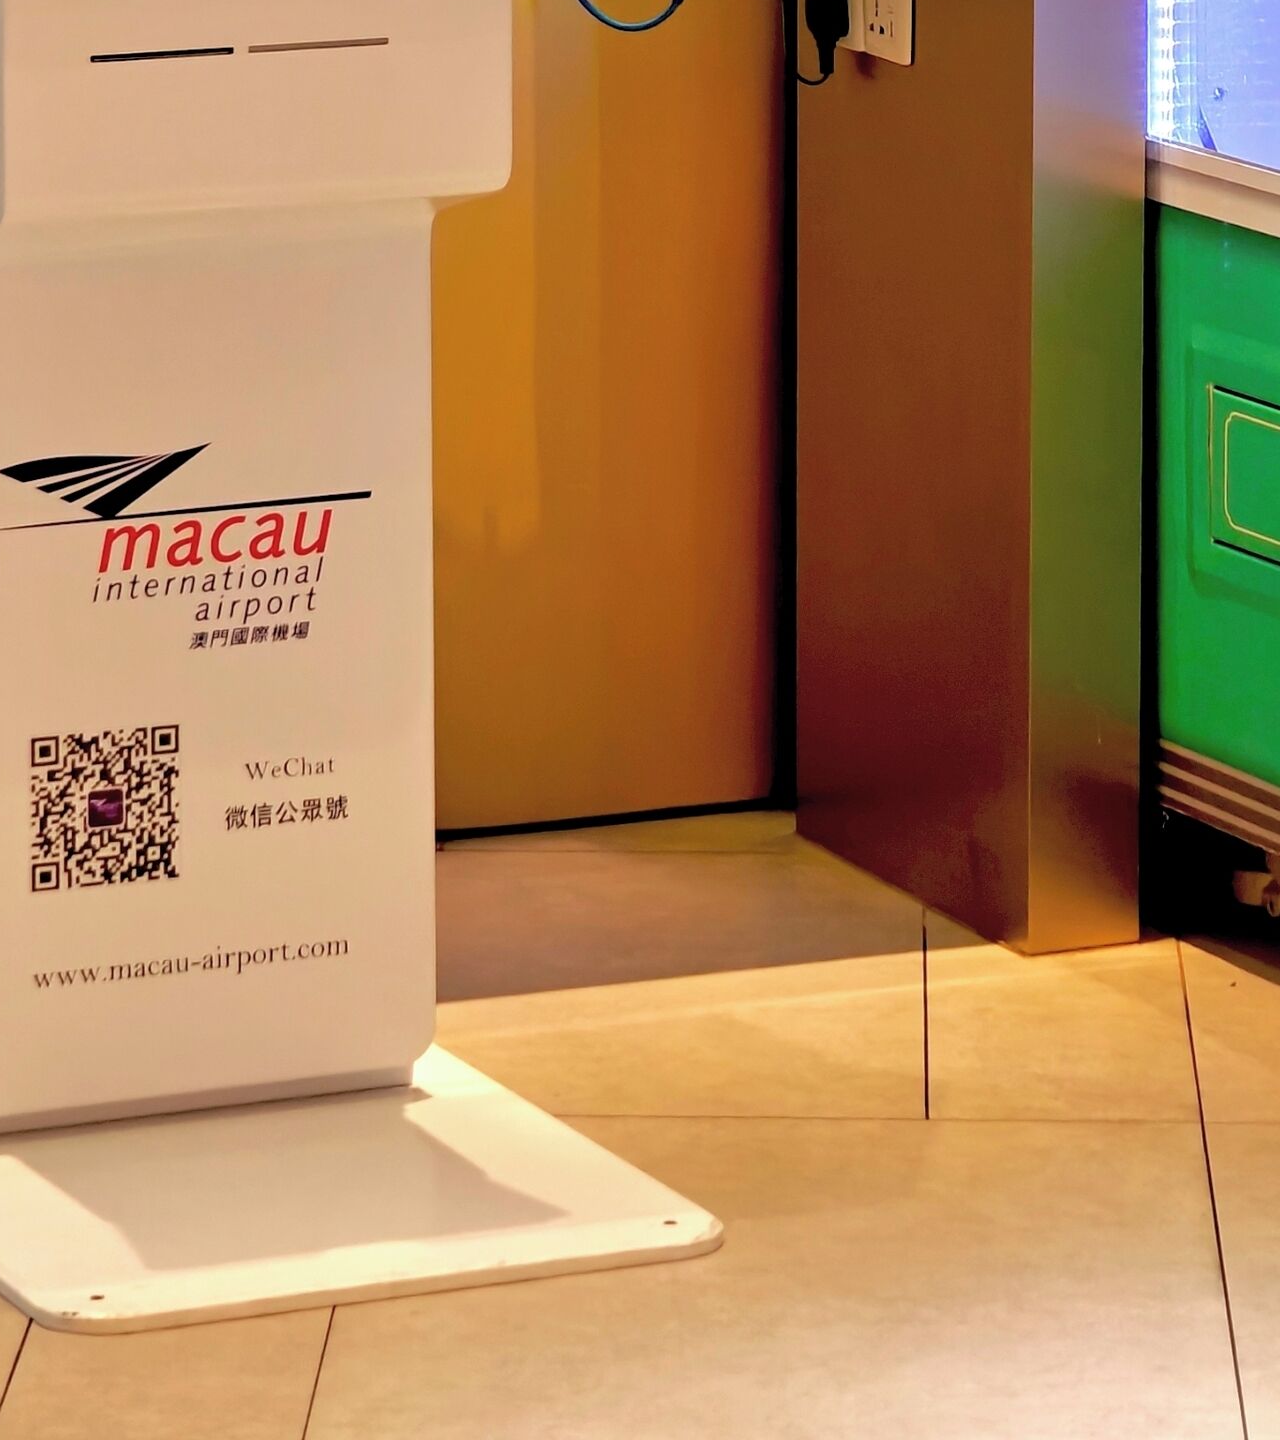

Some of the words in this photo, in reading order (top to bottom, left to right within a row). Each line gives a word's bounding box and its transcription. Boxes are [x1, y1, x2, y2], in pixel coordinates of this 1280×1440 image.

[98, 508, 333, 574] macau
[92, 556, 324, 604] international
[194, 586, 317, 624] airport
[189, 621, 311, 650] 澳門國際機場
[244, 755, 336, 782] WeChat
[224, 794, 349, 831] 微信公眾號
[32, 937, 350, 989] www.macau-airport.com
